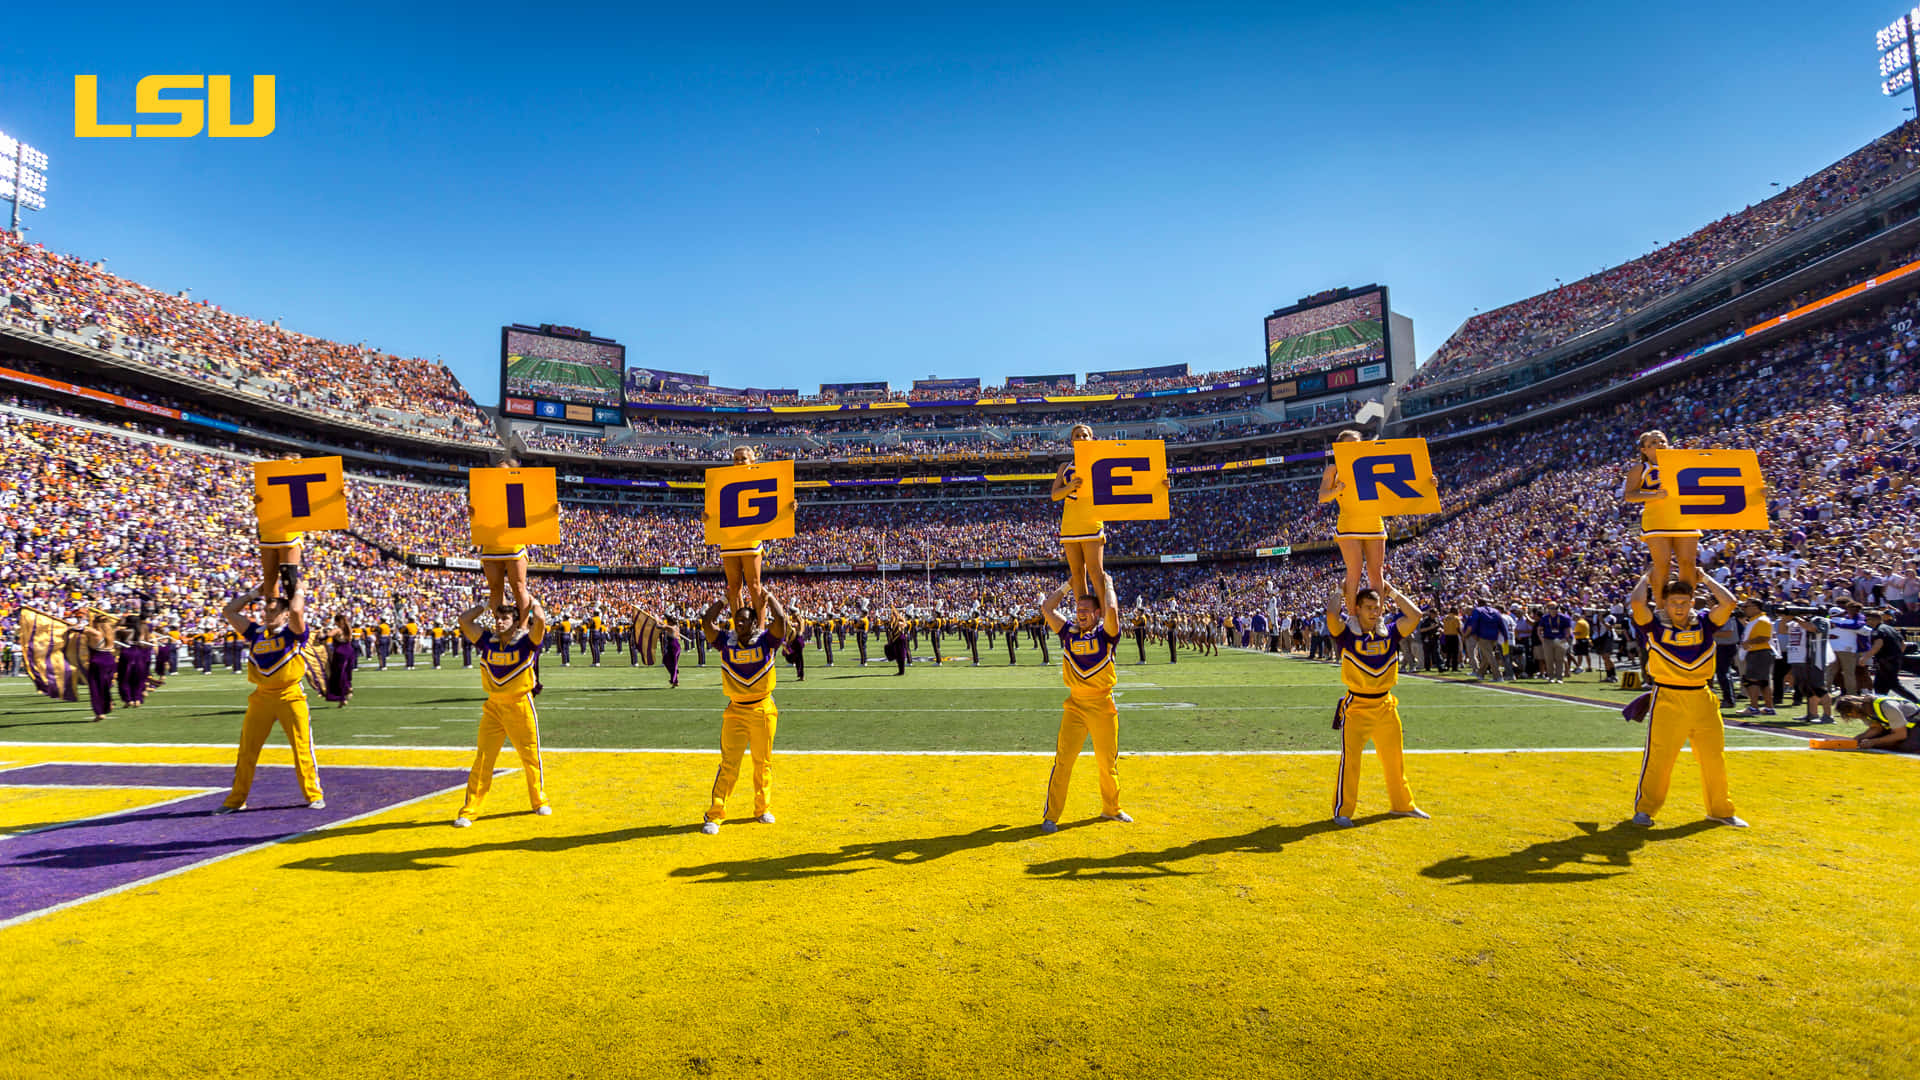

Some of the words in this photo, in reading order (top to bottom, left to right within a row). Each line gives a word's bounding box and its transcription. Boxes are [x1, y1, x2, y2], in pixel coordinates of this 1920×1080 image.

[551, 324, 582, 337] LSU
[848, 455, 912, 465] WELCOME
[919, 454, 934, 462] TO
[938, 452, 979, 461] DEATH
[985, 451, 1030, 460] VALLEY
[1091, 457, 1153, 506] E
[1352, 454, 1424, 501] R
[267, 473, 327, 517] T
[1676, 467, 1746, 514] S
[505, 483, 527, 528] I
[719, 478, 777, 528] G
[252, 636, 286, 655] SU
[1069, 637, 1099, 655] LSU
[1661, 628, 1704, 646] LSU
[729, 646, 764, 664] LSU
[1355, 638, 1392, 656] LSU
[487, 649, 519, 666] LSU
[1623, 672, 1635, 687] 10
